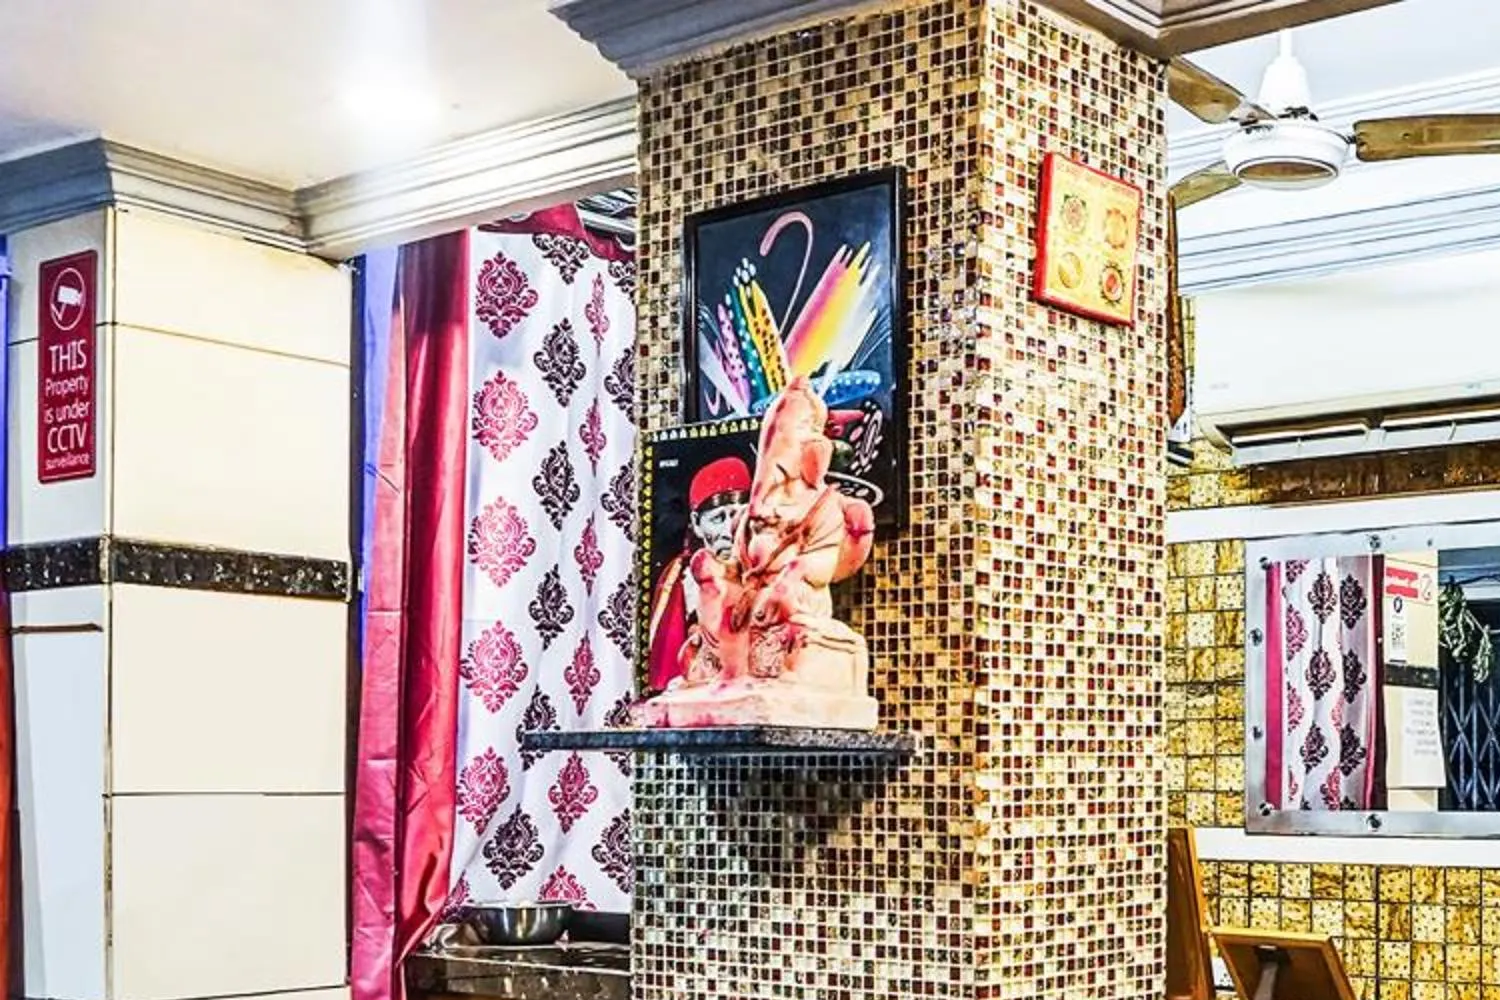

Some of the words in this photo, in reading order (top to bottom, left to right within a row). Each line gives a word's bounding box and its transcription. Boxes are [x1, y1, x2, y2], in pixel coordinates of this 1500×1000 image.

[48, 339, 87, 374] THIS
[45, 376, 89, 397] Property
[44, 403, 54, 424] is
[55, 398, 90, 422] under
[47, 421, 87, 453] CCTV
